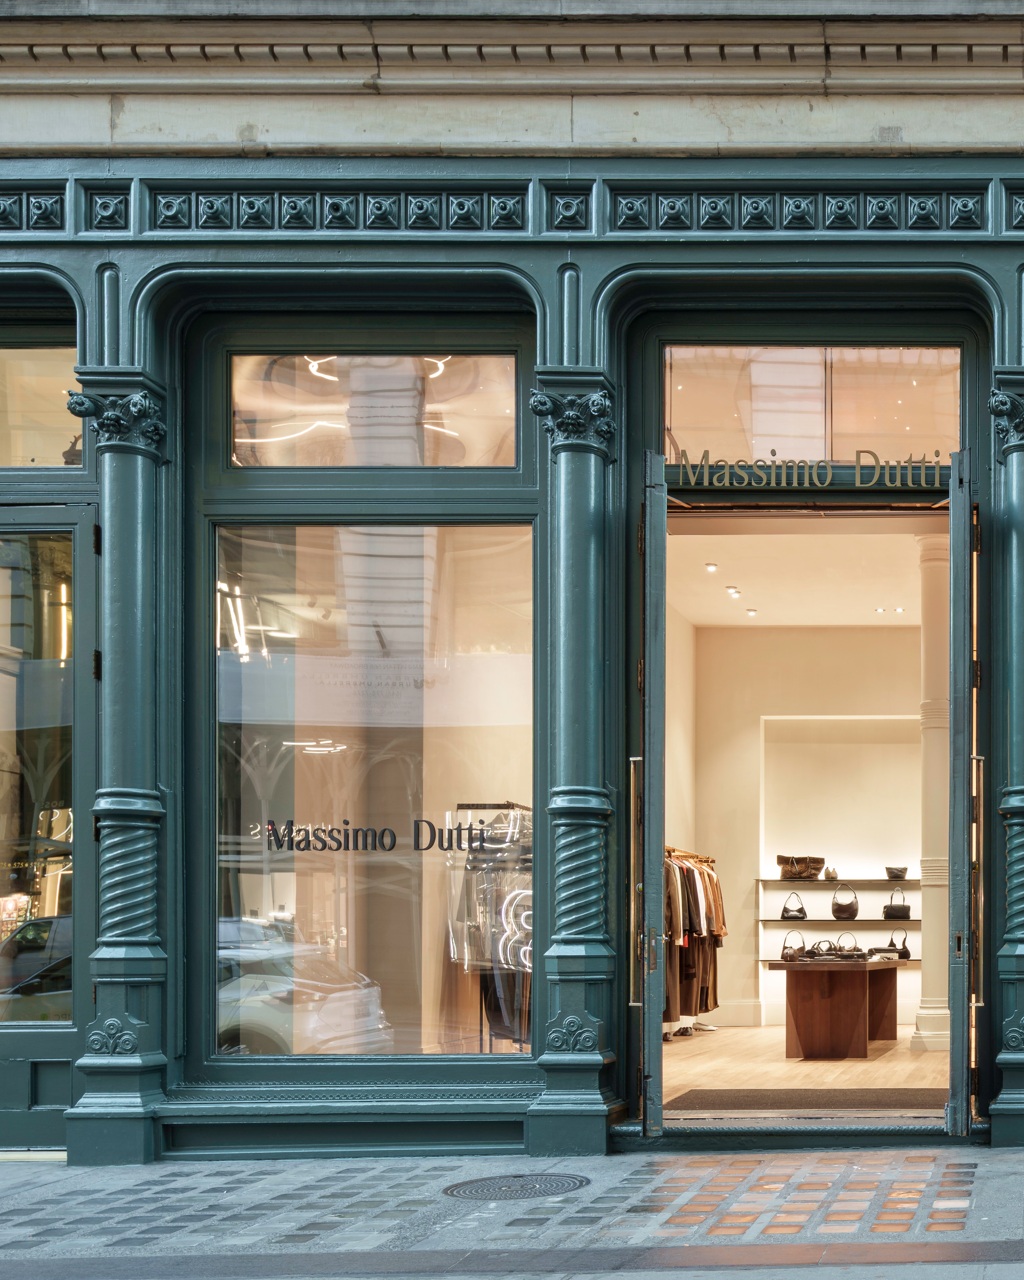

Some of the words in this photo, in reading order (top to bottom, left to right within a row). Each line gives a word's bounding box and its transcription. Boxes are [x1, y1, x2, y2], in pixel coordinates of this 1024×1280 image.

[680, 449, 833, 488] Massimo
[855, 449, 941, 488] Dutti
[267, 819, 397, 852] Massimo
[413, 818, 486, 852] Dutti
